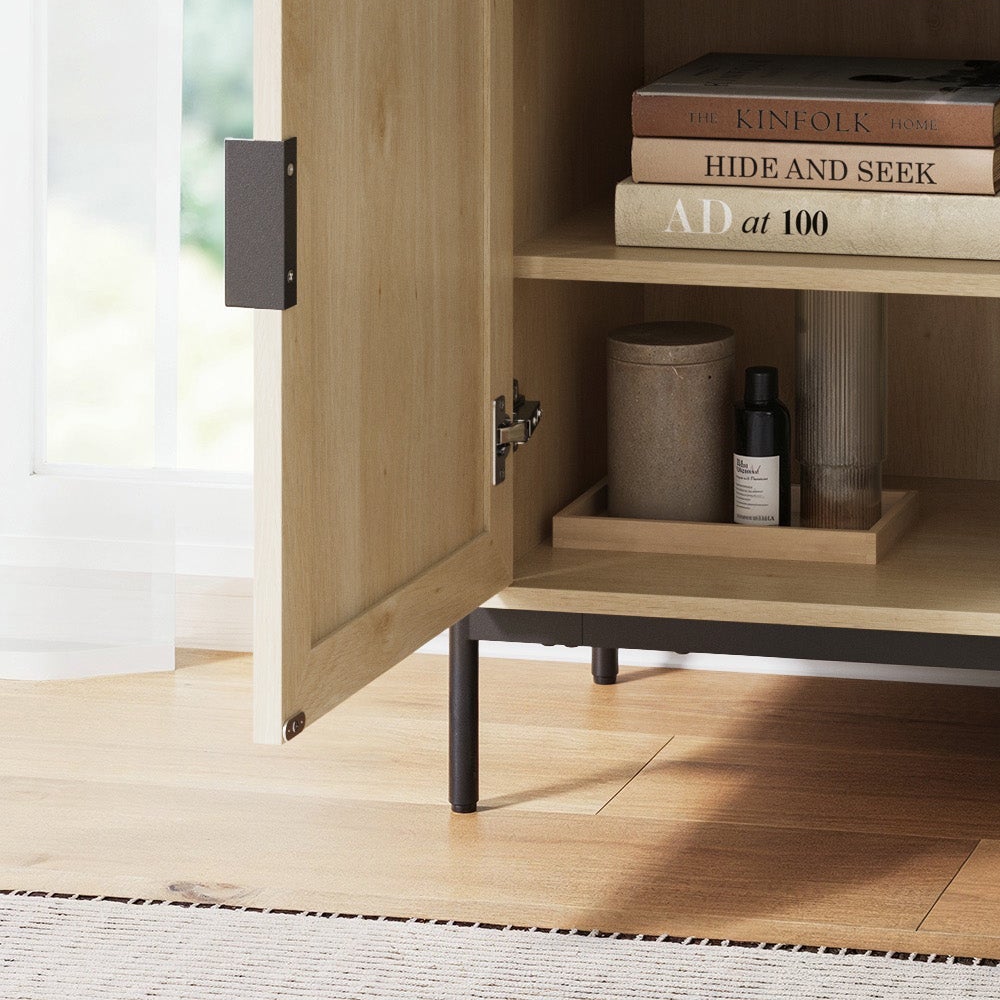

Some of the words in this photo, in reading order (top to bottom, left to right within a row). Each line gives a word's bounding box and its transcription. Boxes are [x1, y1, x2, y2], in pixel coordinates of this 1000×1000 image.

[688, 112, 718, 124] THE
[736, 108, 872, 133] KINFOLK
[890, 118, 939, 132] HOME
[704, 155, 779, 179] HIDE
[784, 158, 849, 182] AND
[857, 160, 938, 185] SEEK
[664, 198, 733, 235] AD
[741, 212, 771, 234] at
[782, 209, 829, 237] 100
